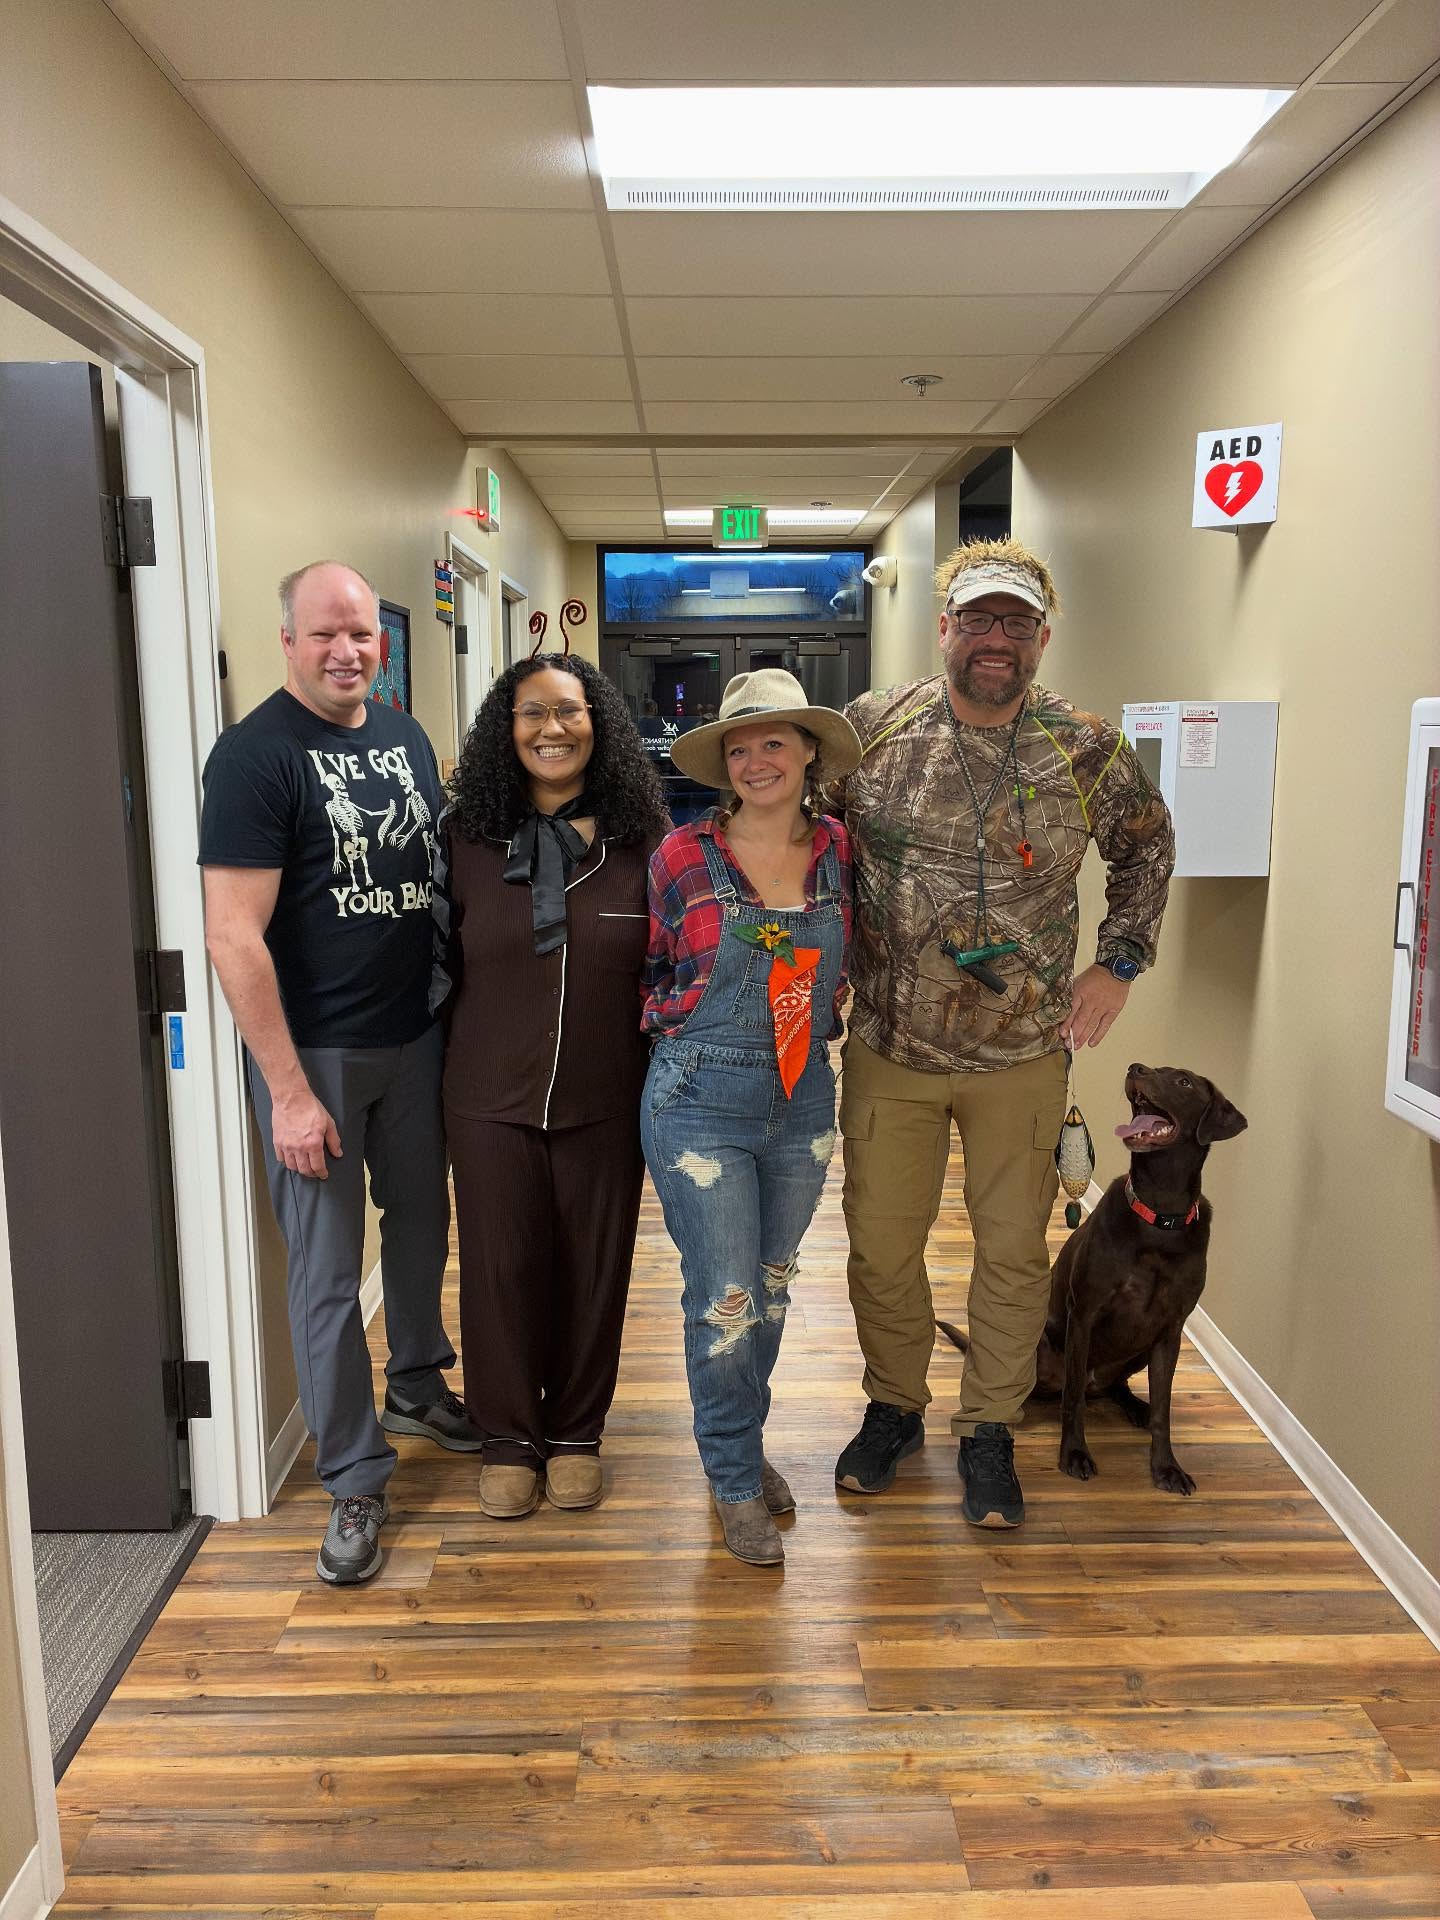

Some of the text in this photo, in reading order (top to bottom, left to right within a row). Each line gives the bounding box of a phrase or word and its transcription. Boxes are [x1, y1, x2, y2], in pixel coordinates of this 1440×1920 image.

[1209, 435, 1262, 461] AED
[722, 509, 761, 540] EXIT
[306, 745, 414, 785] I'VE GOT
[328, 881, 433, 918] YOUR BAC
[1411, 767, 1439, 1057] FIRE EXTINGUISHER
